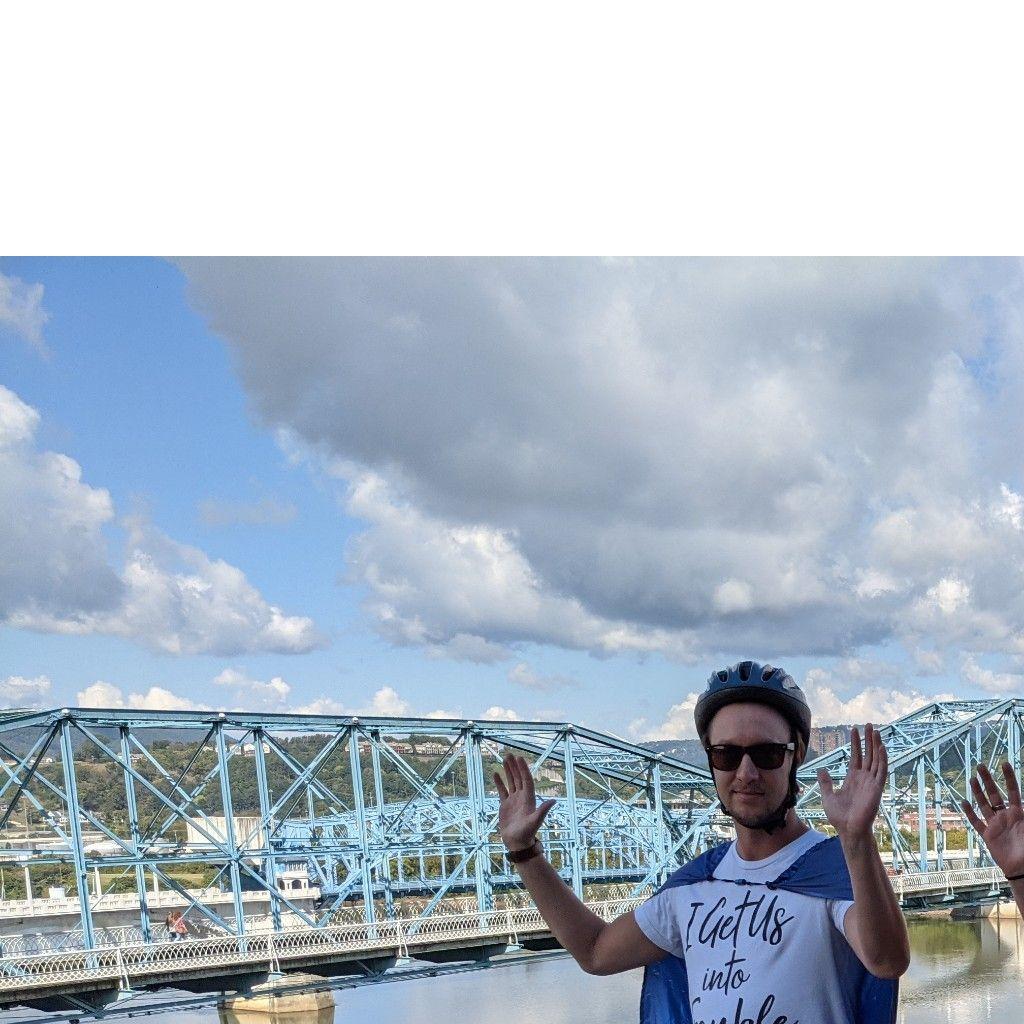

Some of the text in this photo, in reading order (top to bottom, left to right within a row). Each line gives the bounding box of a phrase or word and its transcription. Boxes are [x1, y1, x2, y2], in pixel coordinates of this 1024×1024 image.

[685, 890, 795, 952] I Get Us
[702, 949, 751, 996] into
